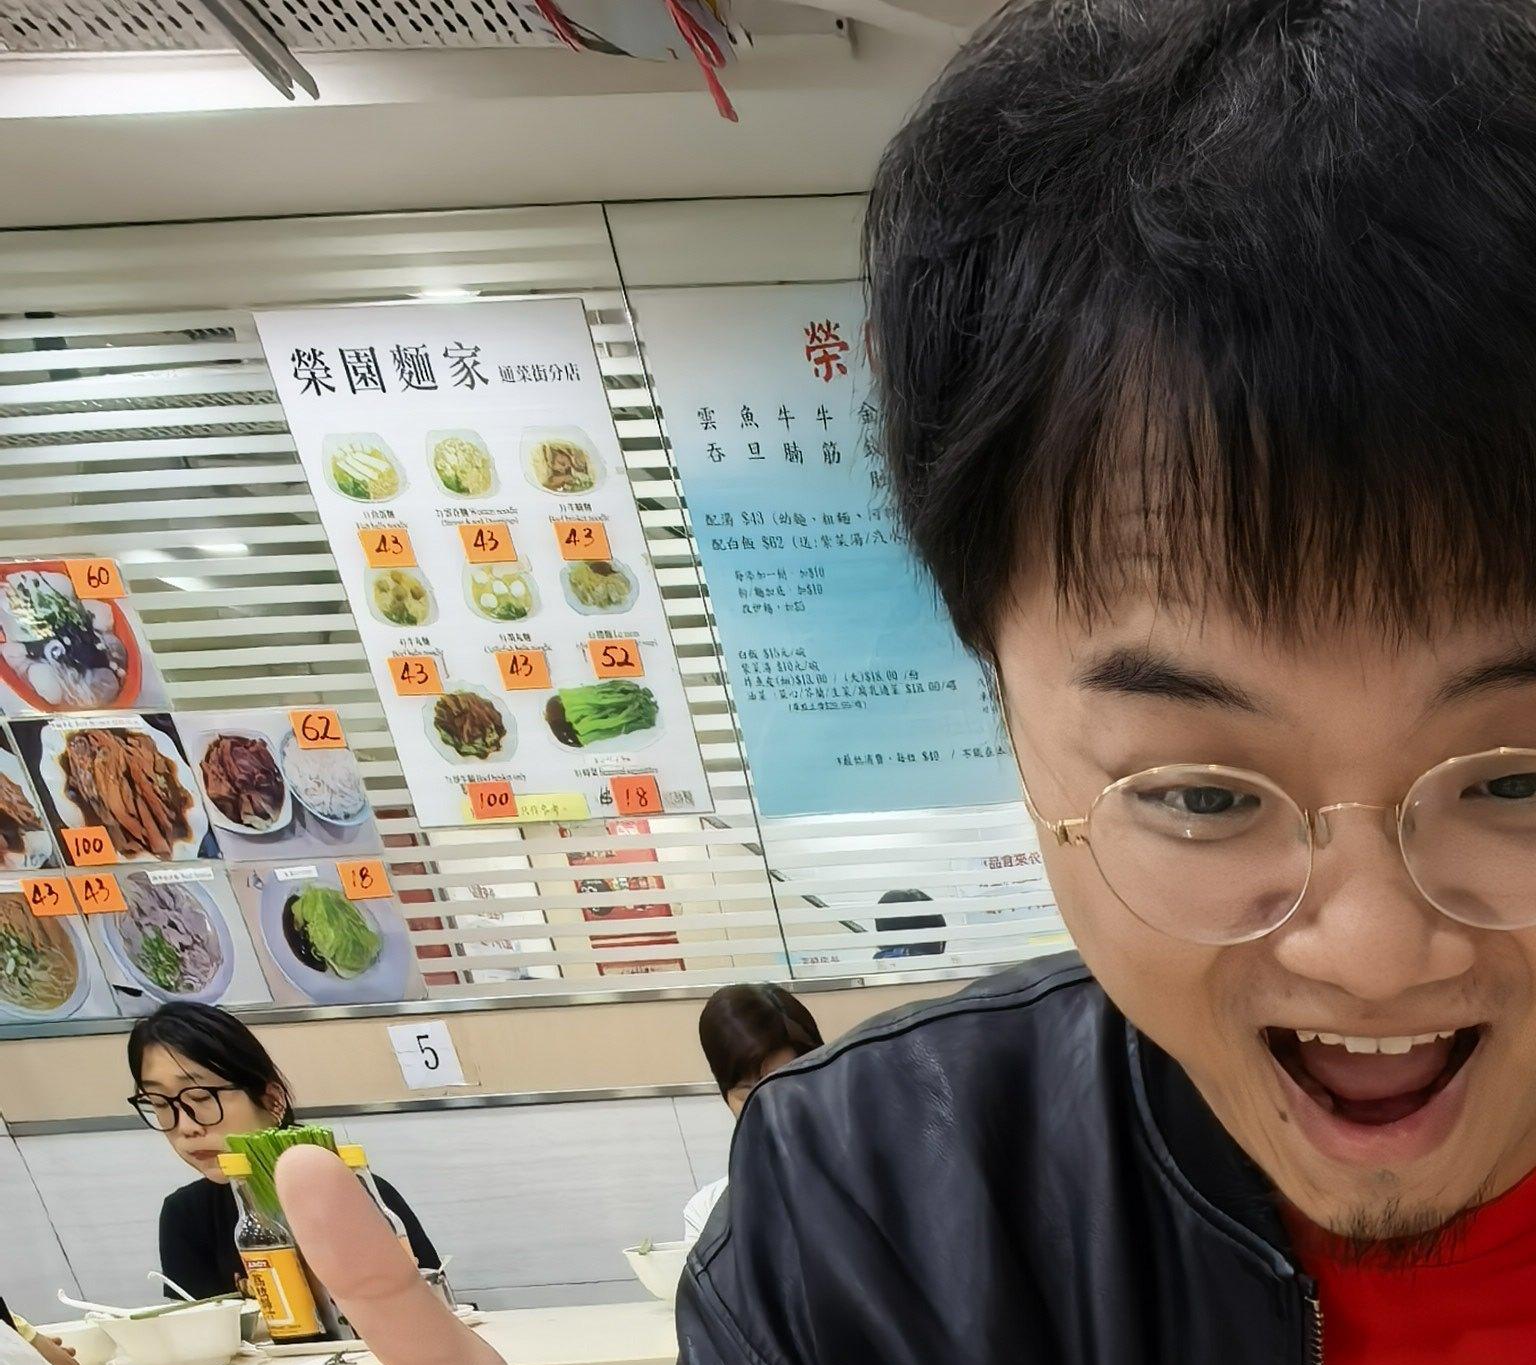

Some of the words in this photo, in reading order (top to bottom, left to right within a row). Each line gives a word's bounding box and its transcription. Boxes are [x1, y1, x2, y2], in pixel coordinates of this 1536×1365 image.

[375, 534, 403, 554] 43
[473, 528, 500, 551] 43
[564, 527, 595, 547] 43
[86, 566, 110, 588] 60
[509, 654, 533, 676] 43
[600, 646, 635, 667] 52
[400, 662, 429, 685] 43
[301, 715, 341, 741] 62
[479, 791, 510, 809] 100
[625, 787, 649, 809] 18
[74, 837, 104, 855] 100
[351, 867, 374, 889] 18
[32, 883, 59, 905] 43
[84, 877, 110, 903] 43
[417, 1033, 440, 1071] 5
